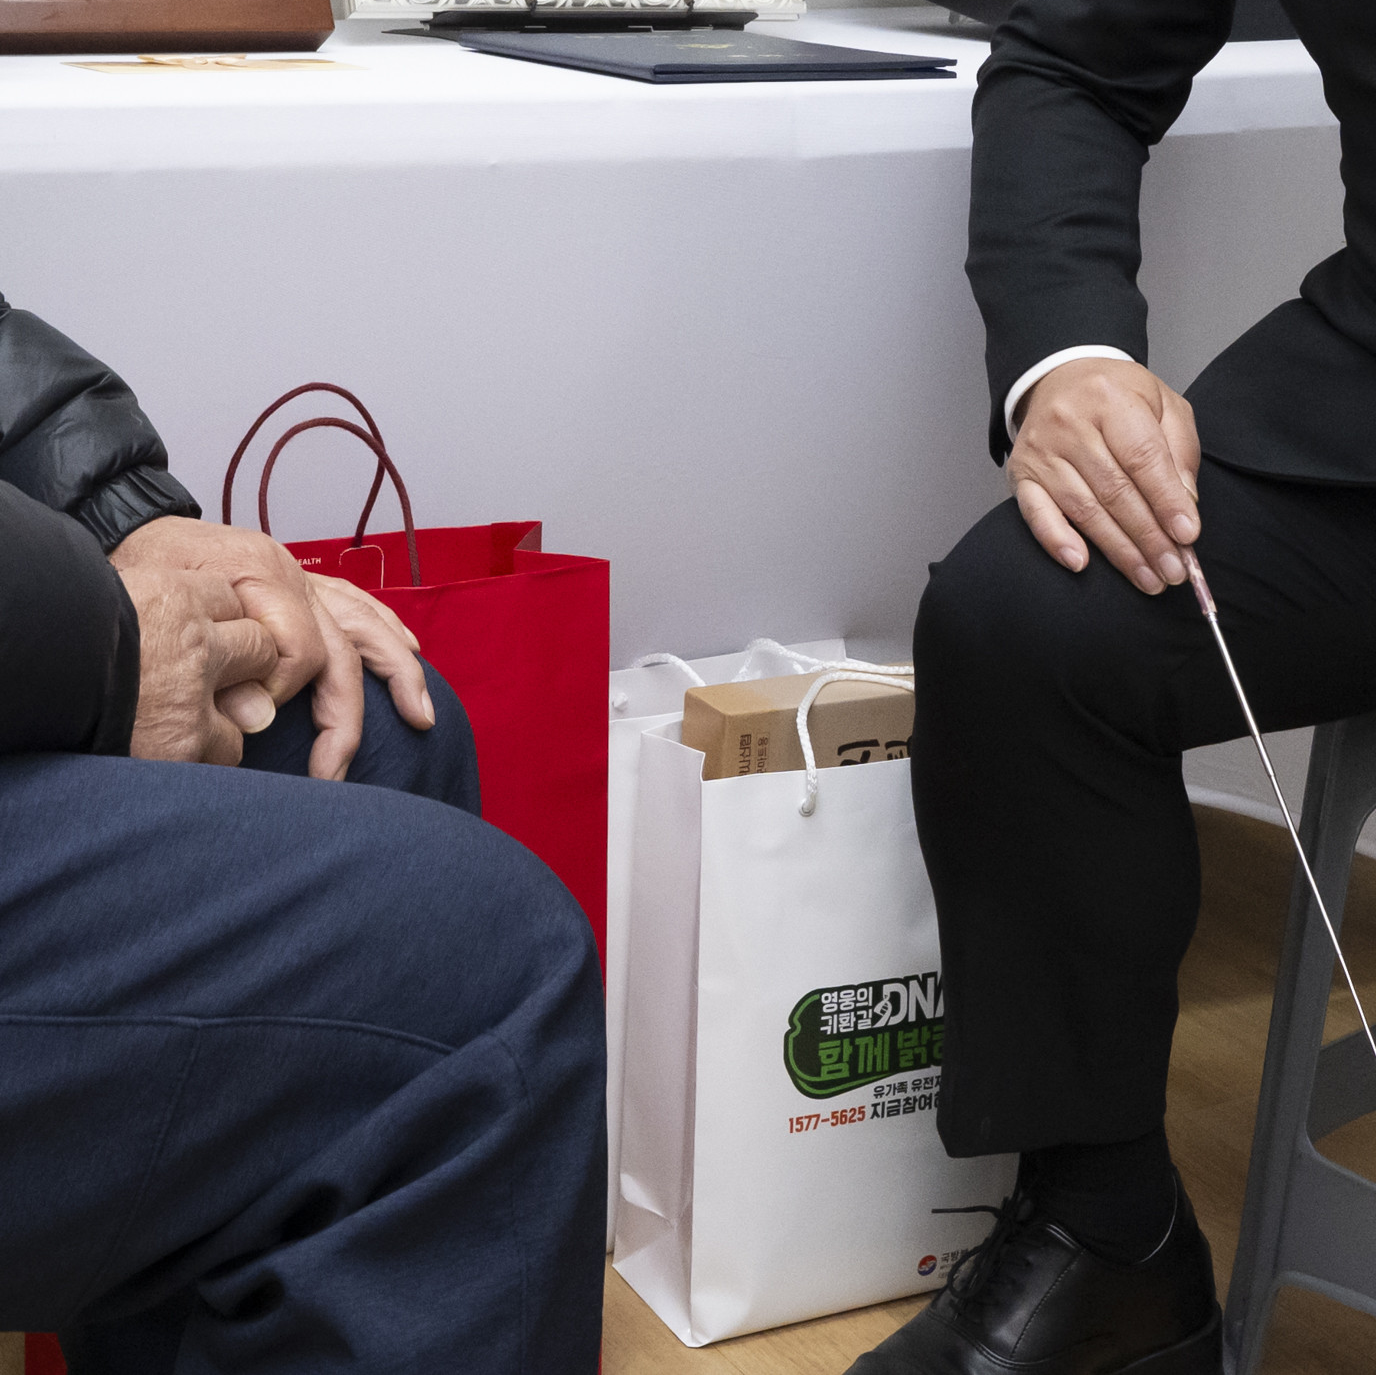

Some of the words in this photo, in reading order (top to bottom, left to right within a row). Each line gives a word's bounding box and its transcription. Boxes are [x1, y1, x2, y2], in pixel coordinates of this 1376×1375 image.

[296, 557, 322, 566] EALTH
[821, 986, 873, 1013] 영웅의
[820, 1009, 872, 1035] 귀환길
[818, 1032, 890, 1078] 함께
[873, 1081, 908, 1099] 유가족
[788, 1105, 866, 1134] 1577-5625
